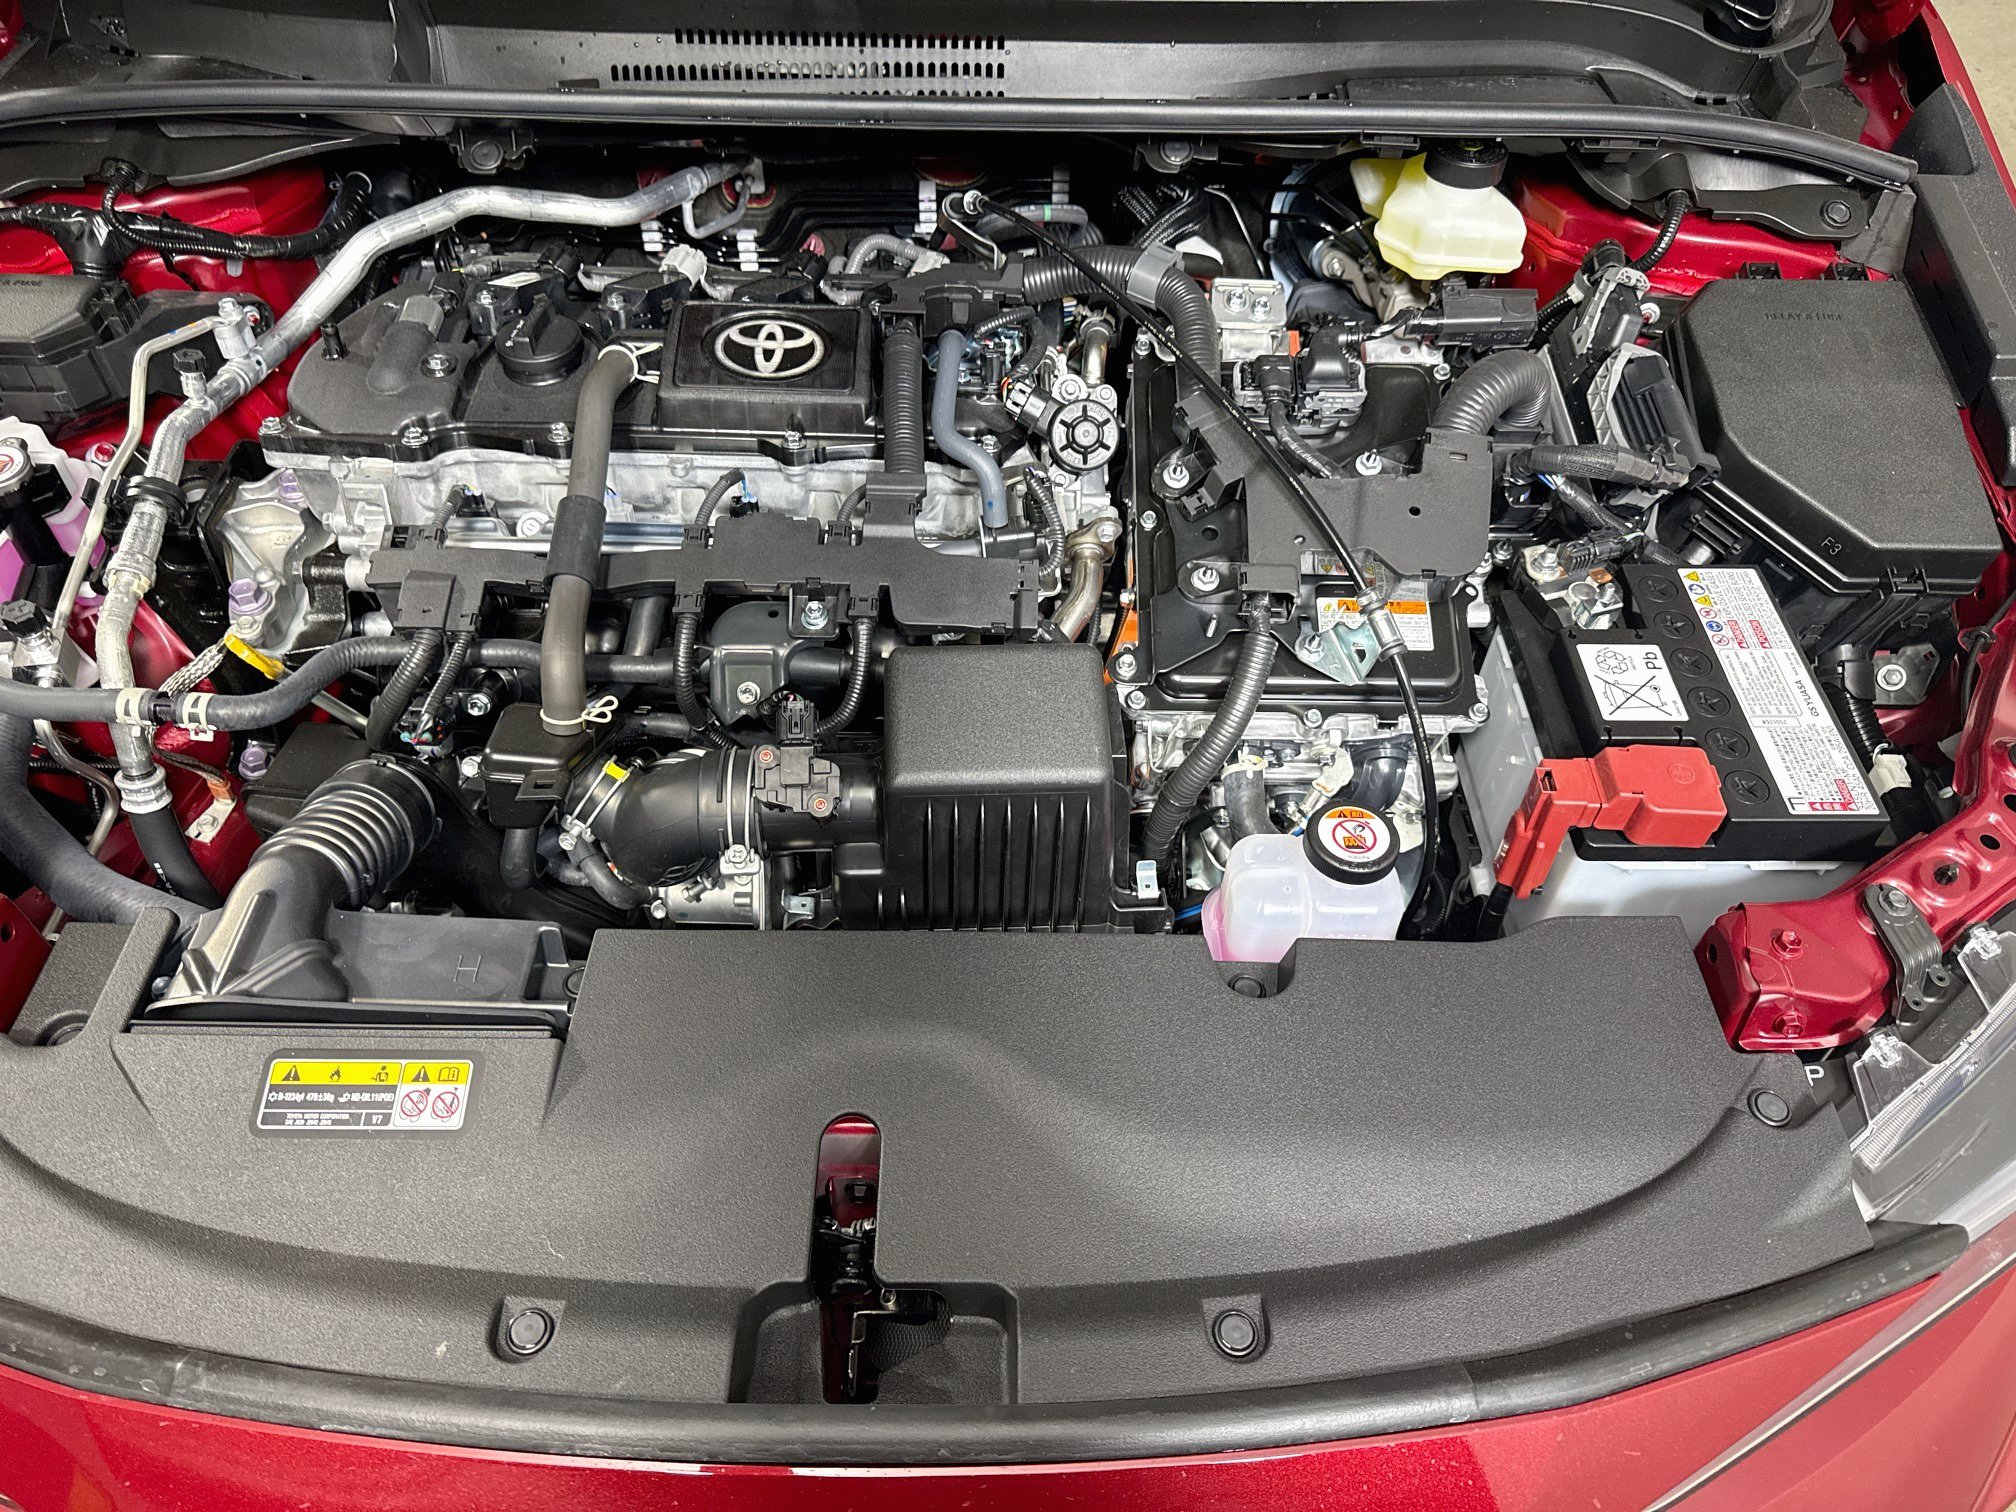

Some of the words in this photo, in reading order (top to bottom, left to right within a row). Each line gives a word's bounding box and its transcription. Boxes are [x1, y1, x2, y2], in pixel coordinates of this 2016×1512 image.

[1821, 537, 1842, 555] F3
[1642, 652, 1662, 669] Pb
[1793, 679, 1814, 705] YUASA
[1807, 706, 1819, 716] GS
[1834, 779, 1854, 802] DANGER
[453, 954, 482, 983] H
[1804, 1065, 1825, 1087] P
[372, 1114, 383, 1124] V7
